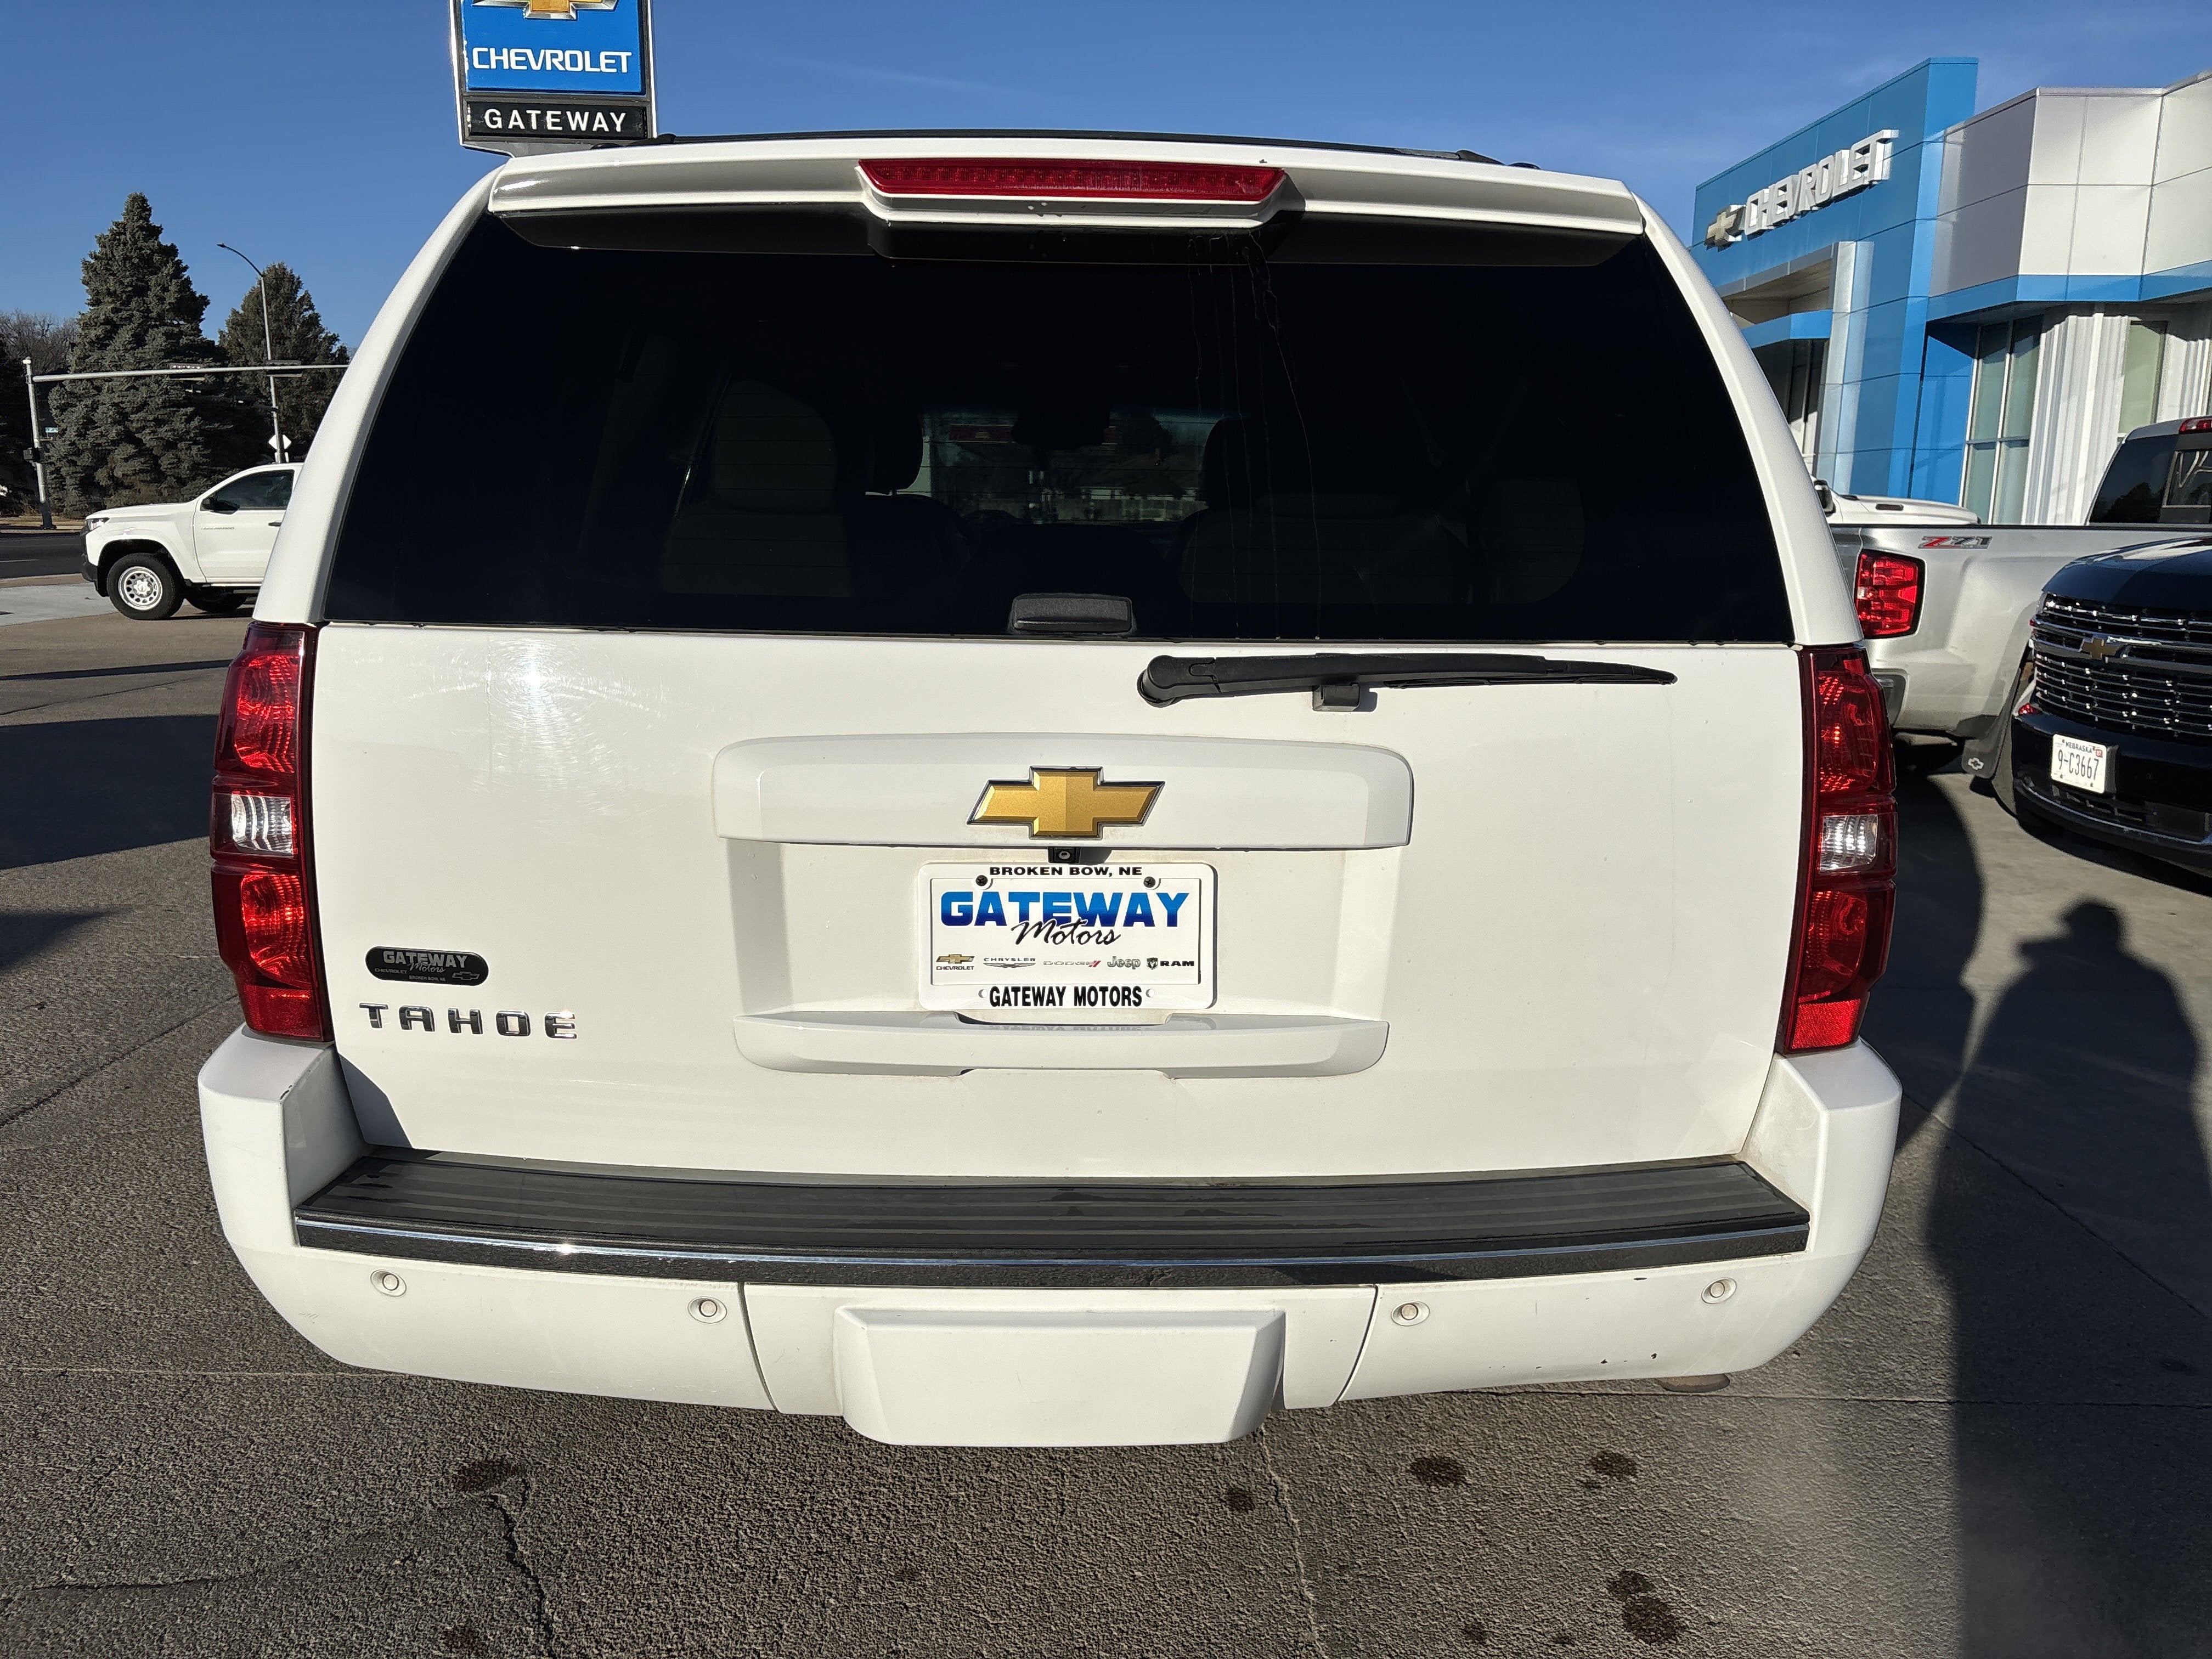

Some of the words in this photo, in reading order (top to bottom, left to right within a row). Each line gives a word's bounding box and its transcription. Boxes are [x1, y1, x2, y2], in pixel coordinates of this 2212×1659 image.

[472, 47, 632, 74] CHEVROLET
[484, 109, 626, 132] GATEWAY
[1744, 129, 1900, 236] CHEVROLET
[1918, 535, 1993, 549] Z71
[2066, 742, 2092, 753] NEBRASKA
[2058, 749, 2099, 780] 9-C3667
[989, 867, 1063, 876] BROKEN
[1069, 867, 1113, 877] BOW,
[1119, 867, 1142, 876] NE
[940, 891, 1190, 927] GATEWAY
[1011, 918, 1121, 945] Motors
[383, 951, 467, 968] GATEWAY
[408, 961, 446, 973] Motors
[1107, 956, 1141, 970] Jeep
[989, 986, 1065, 1007] GATEWAY
[1074, 986, 1142, 1007] MOTORS
[359, 1002, 577, 1039] TAHOE
